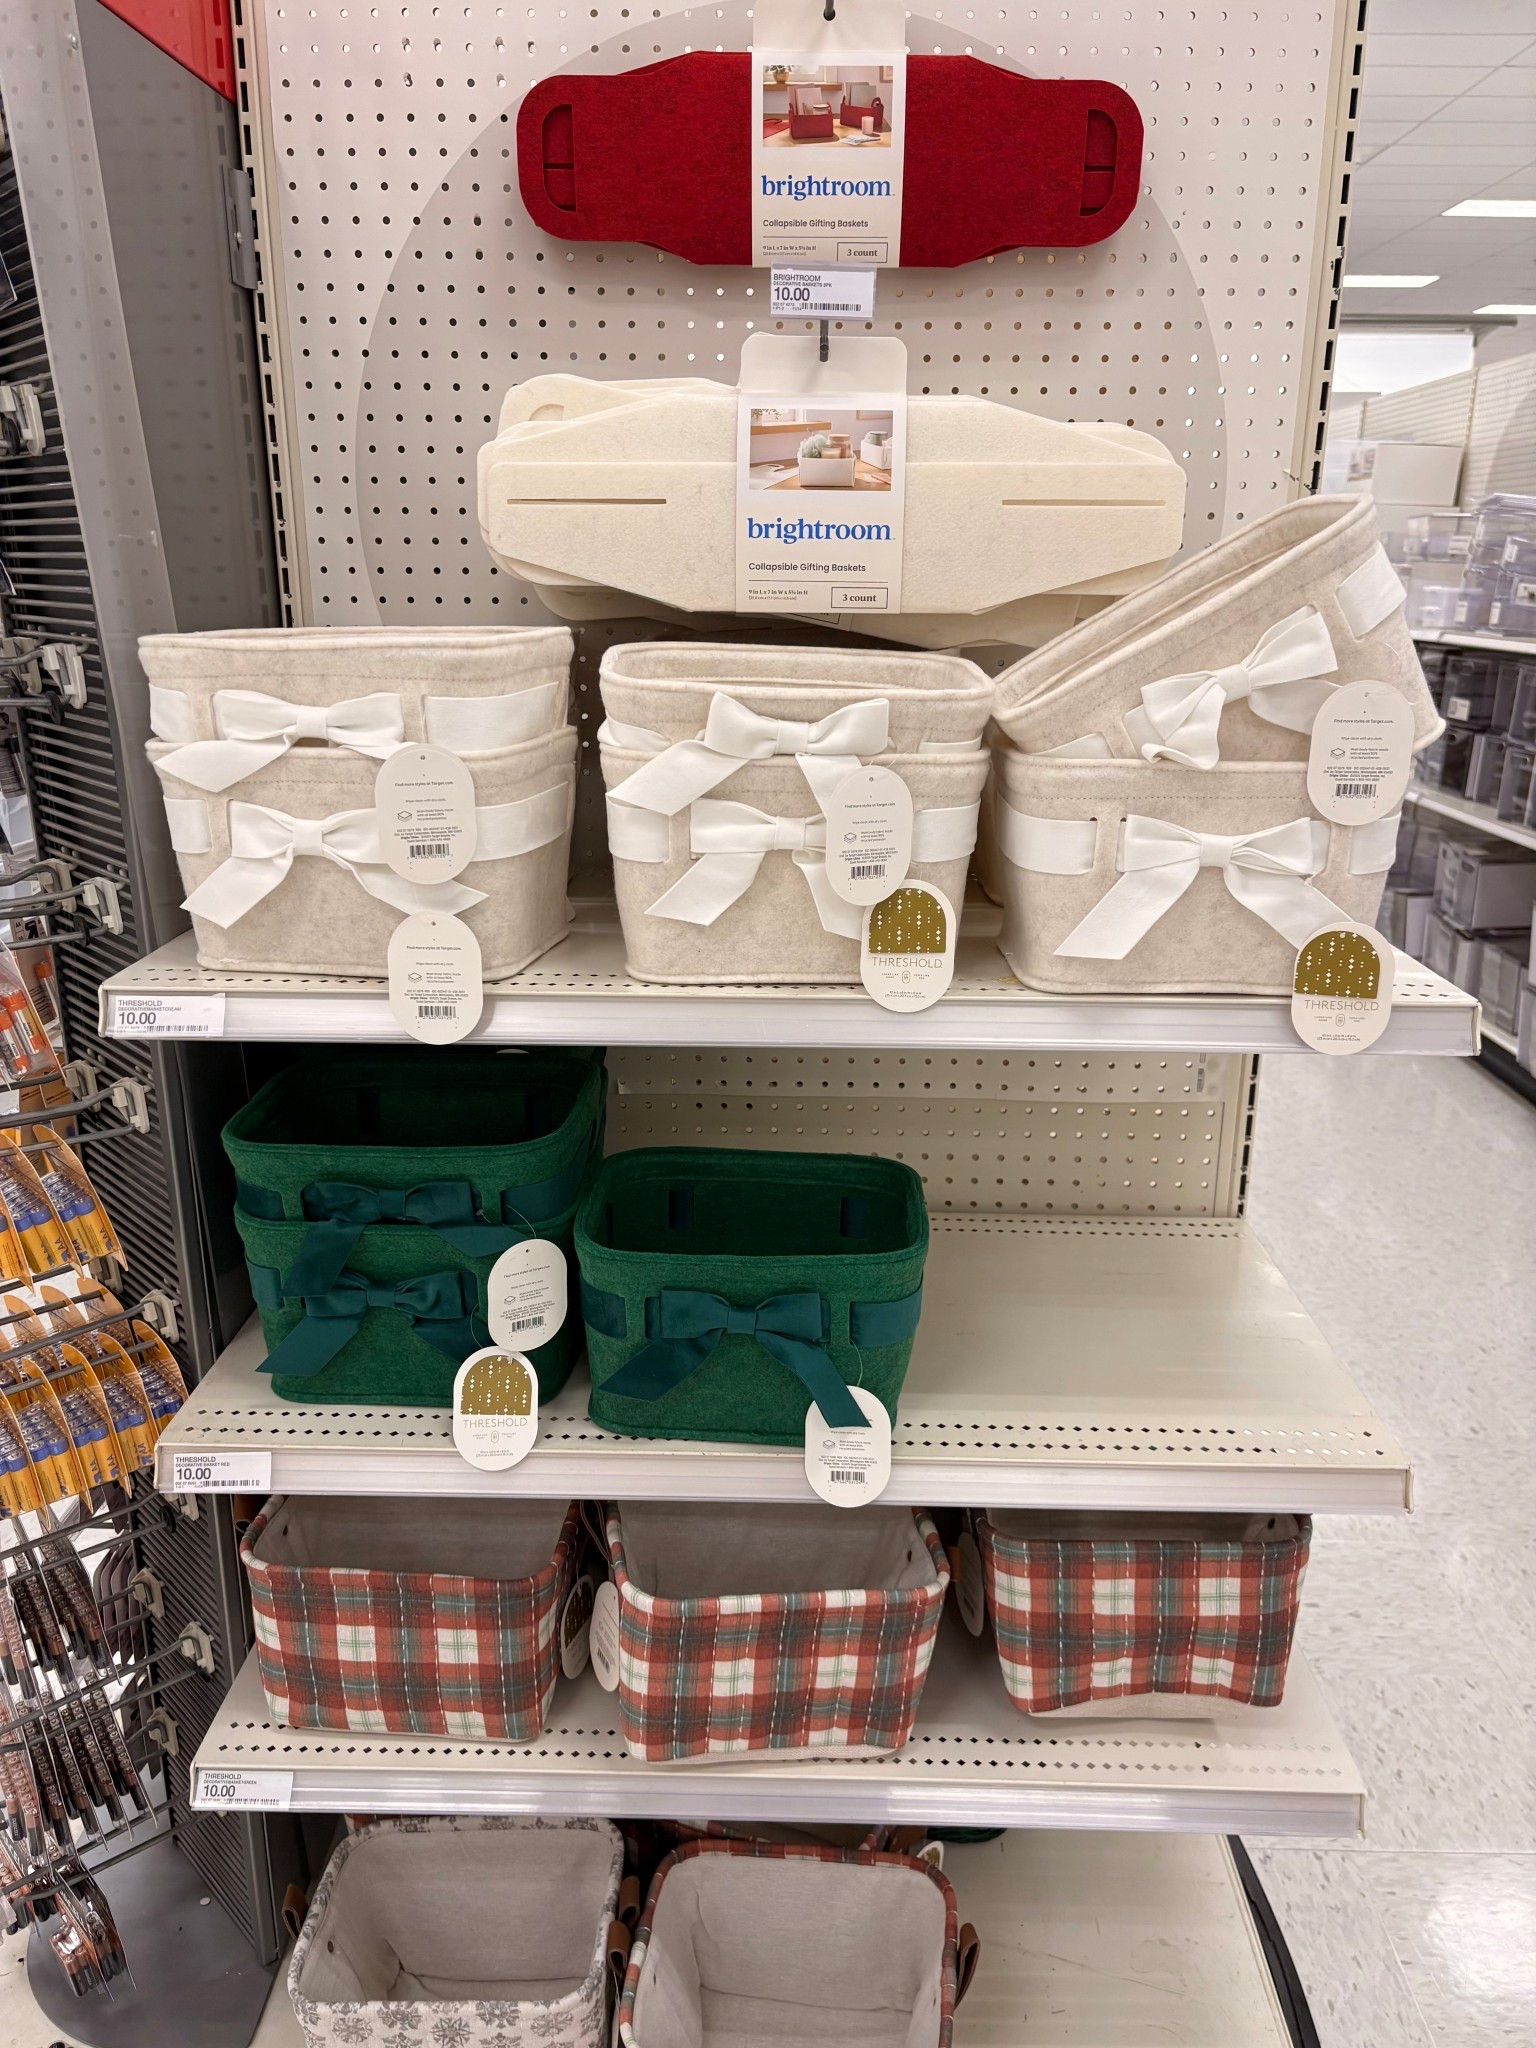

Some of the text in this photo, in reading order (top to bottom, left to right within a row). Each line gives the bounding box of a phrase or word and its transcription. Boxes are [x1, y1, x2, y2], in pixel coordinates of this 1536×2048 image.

[761, 174, 891, 201] brightroom
[762, 219, 869, 229] Collapsible Gifting Baskets
[847, 249, 878, 257] 3 count
[773, 274, 821, 282] BRIGHTROOM
[774, 287, 810, 301] 10.00
[747, 517, 892, 545] brightroom
[748, 562, 866, 573] Collapsible Gifting Baskets
[842, 594, 877, 602] 3 count
[872, 956, 943, 968] THRESHOLD
[1304, 1000, 1379, 1011] THRESHOLD
[119, 1012, 157, 1025] 10.00
[463, 1417, 528, 1429] THRESHOLD
[176, 1468, 212, 1480] 10.00
[204, 1784, 236, 1797] 10.00
